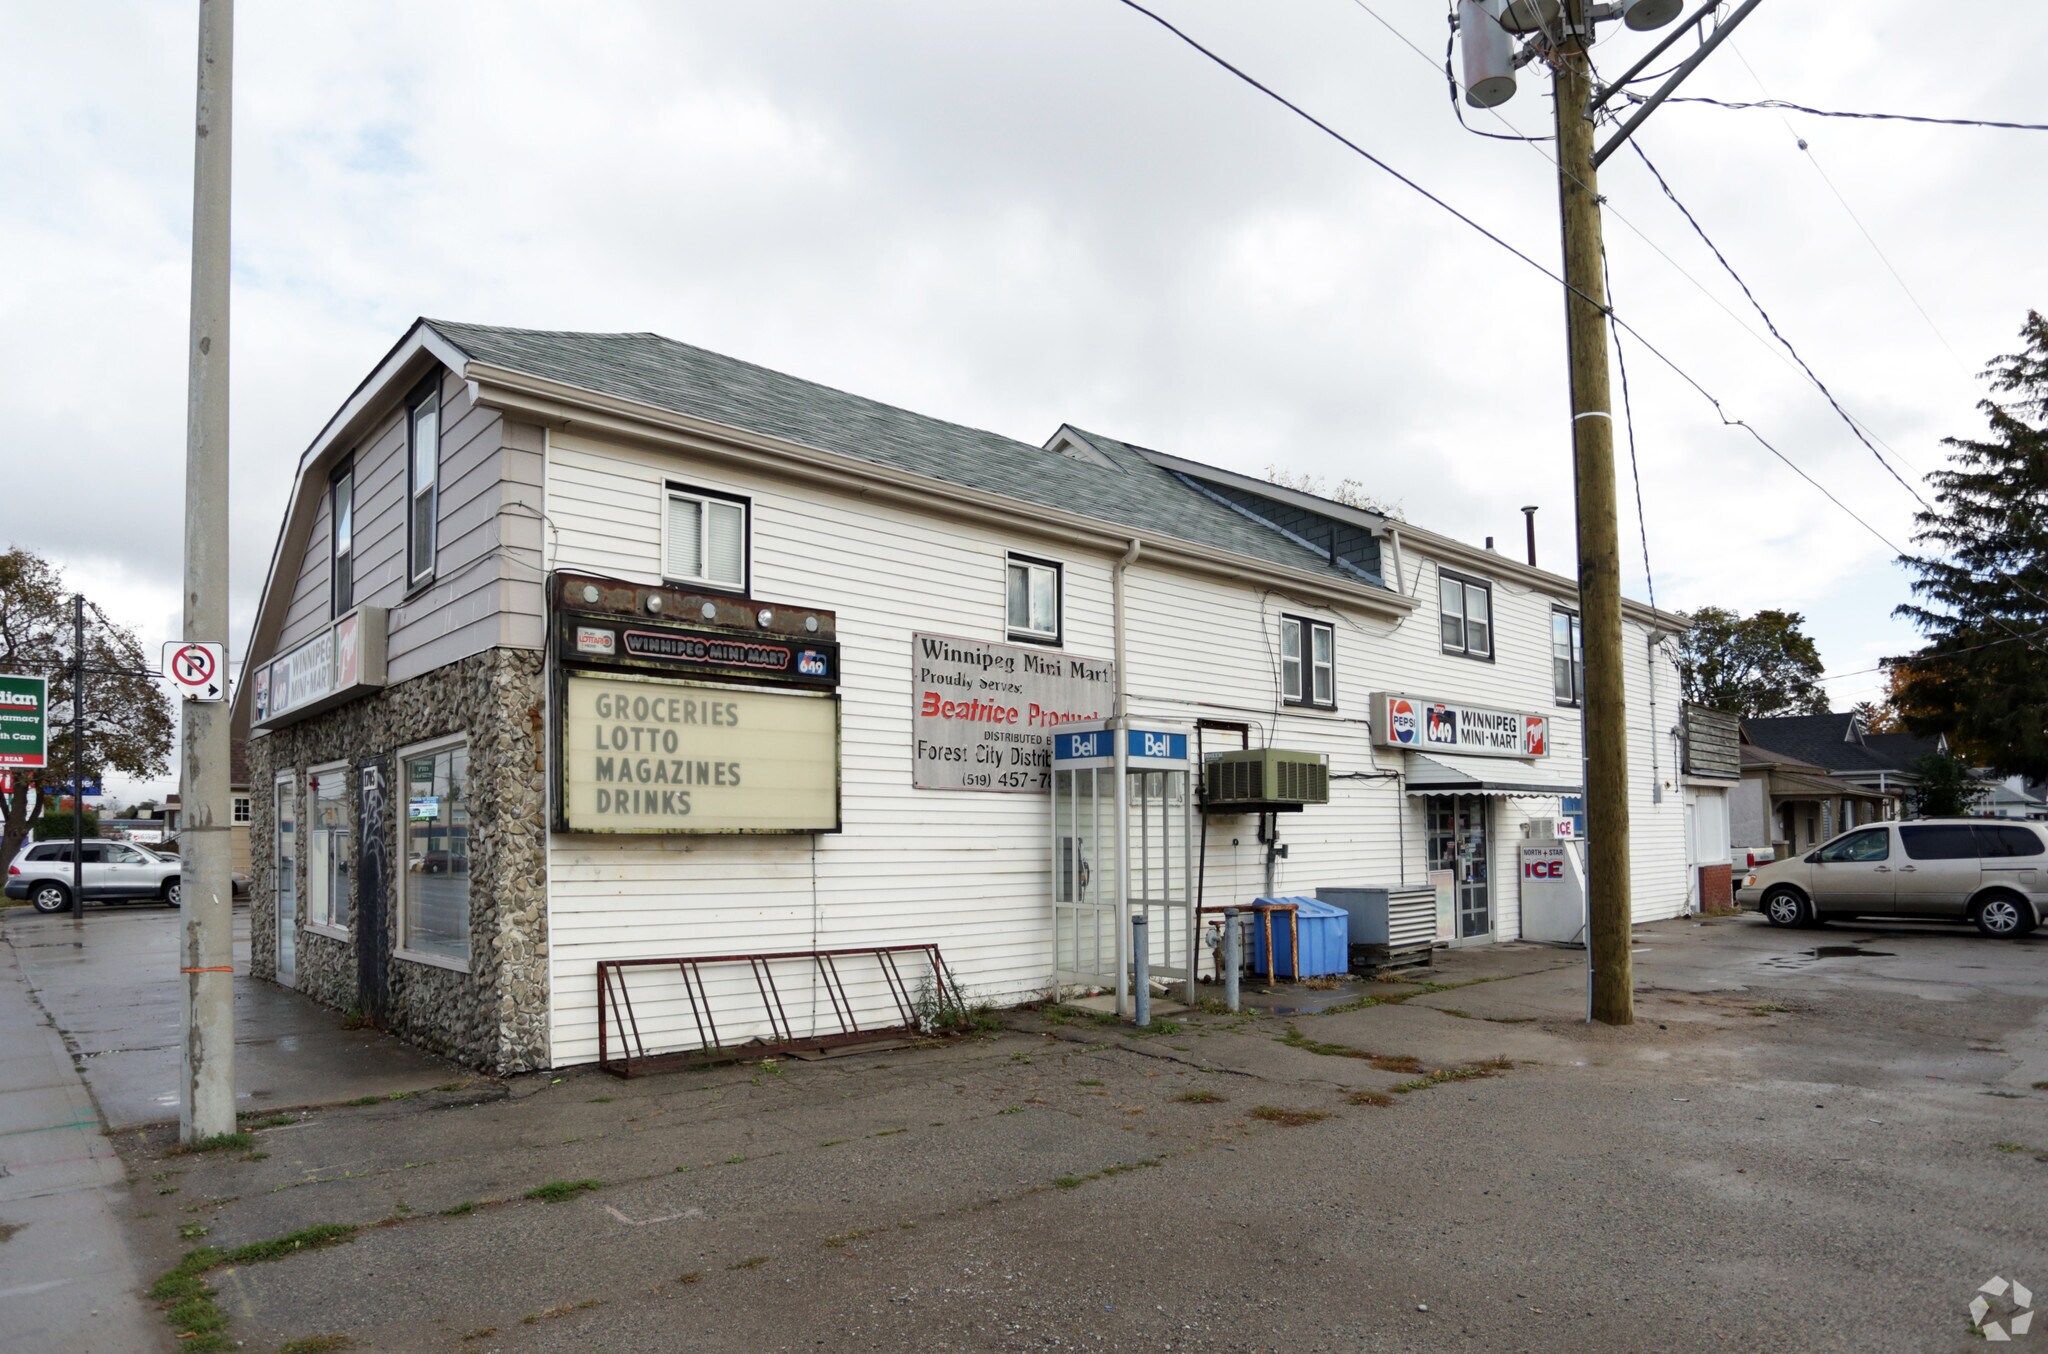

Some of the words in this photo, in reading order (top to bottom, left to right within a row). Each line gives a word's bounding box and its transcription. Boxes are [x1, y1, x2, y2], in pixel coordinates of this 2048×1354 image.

[292, 636, 331, 676] WINNIPEG
[628, 635, 705, 657] WINNIPEG
[709, 644, 744, 661] MINI
[747, 649, 786, 665] MART
[921, 638, 1015, 674] Winnipeg
[1023, 653, 1061, 677] Mini
[1070, 661, 1109, 683] Mart
[595, 693, 738, 727] GROCERIES
[921, 691, 1019, 725] Beatrice
[1393, 715, 1416, 728] PEPSI
[1461, 710, 1517, 733] WINNIPEG
[12, 733, 37, 741] Care
[595, 725, 679, 754] LOTTO
[984, 731, 1042, 745] DISTRIBUTED
[1071, 733, 1097, 757] Bell
[1144, 733, 1170, 757] Bell
[917, 739, 968, 762] Forest
[975, 744, 1004, 769] City
[595, 757, 741, 786] MAGAZINES
[962, 773, 991, 787] (519)
[596, 789, 691, 816] DRINKS
[1557, 821, 1571, 836] ICE
[1523, 848, 1542, 856] NORTH
